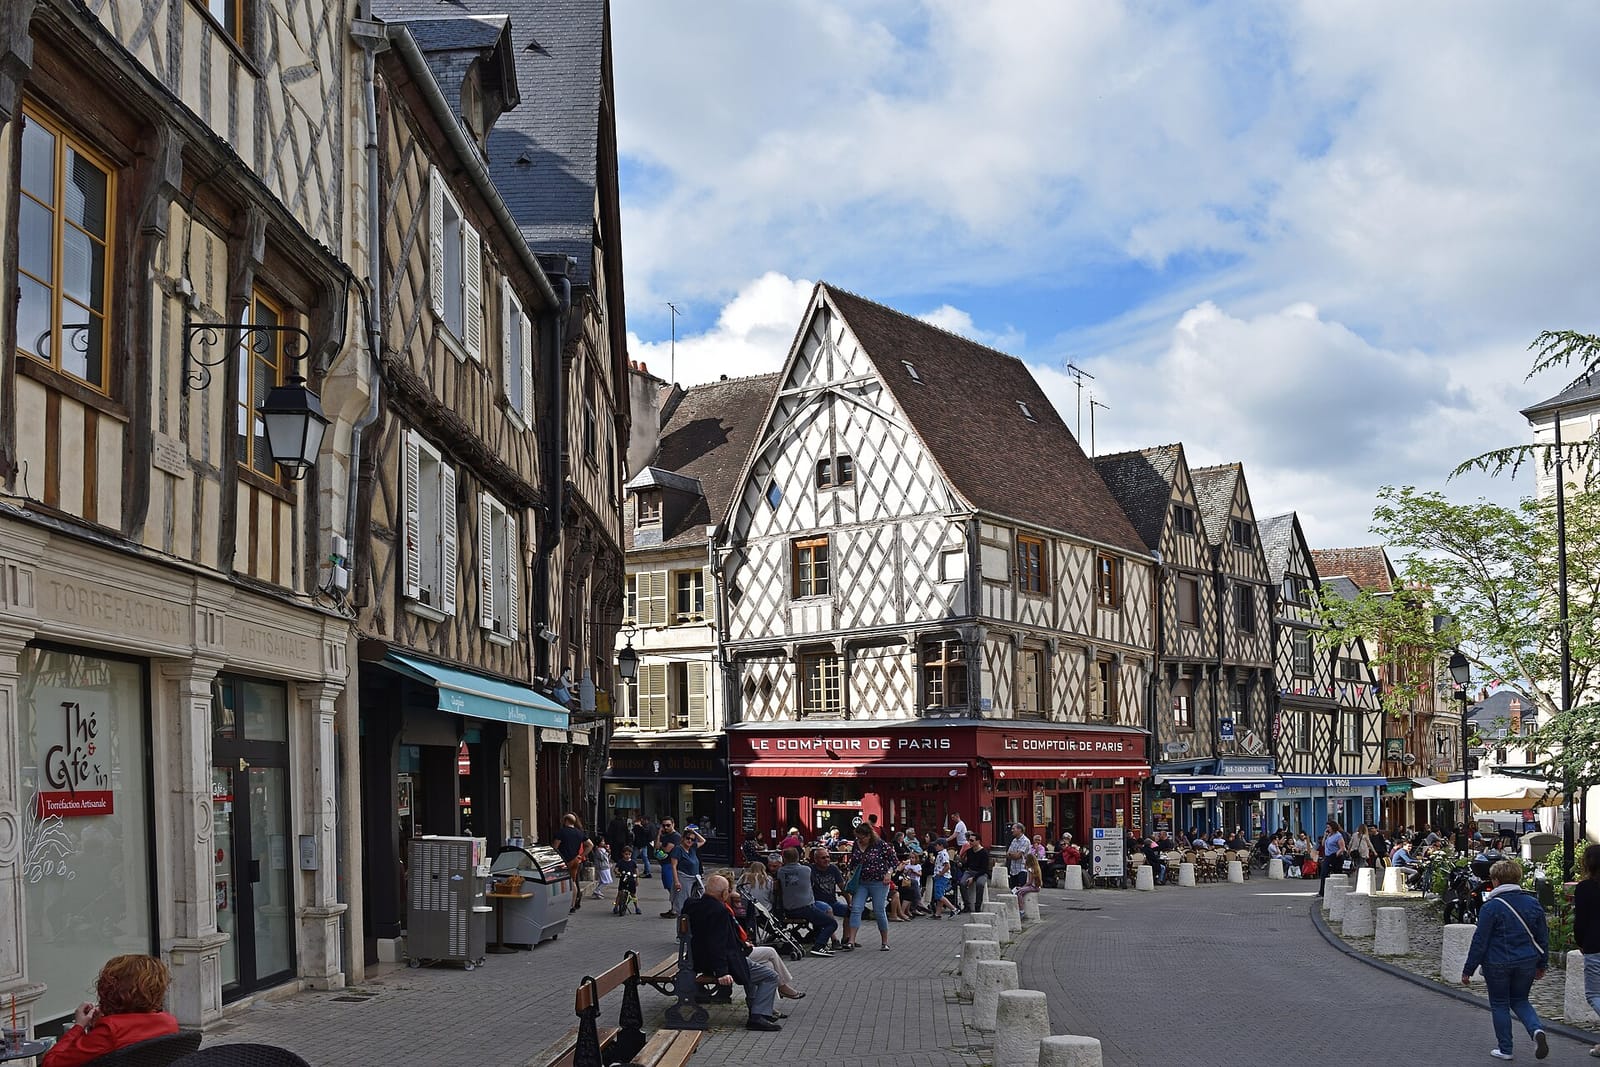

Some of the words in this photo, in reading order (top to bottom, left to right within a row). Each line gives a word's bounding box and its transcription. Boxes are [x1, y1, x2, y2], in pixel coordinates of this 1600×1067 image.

[50, 580, 181, 635] TORREFACTION
[240, 626, 306, 660] ARTISANALE
[60, 701, 98, 757] Thé
[751, 739, 769, 750] LE
[776, 739, 861, 750] COMPTOIR
[868, 739, 891, 750] DE
[898, 738, 951, 749] PARIS
[1004, 738, 1018, 750] LE
[1022, 739, 1076, 751] COMPTOIR
[1079, 741, 1092, 751] DE
[1095, 741, 1123, 752] PARIS
[45, 745, 90, 798] Café
[46, 798, 80, 810] Torréfaction
[81, 797, 106, 809] Artisanale
